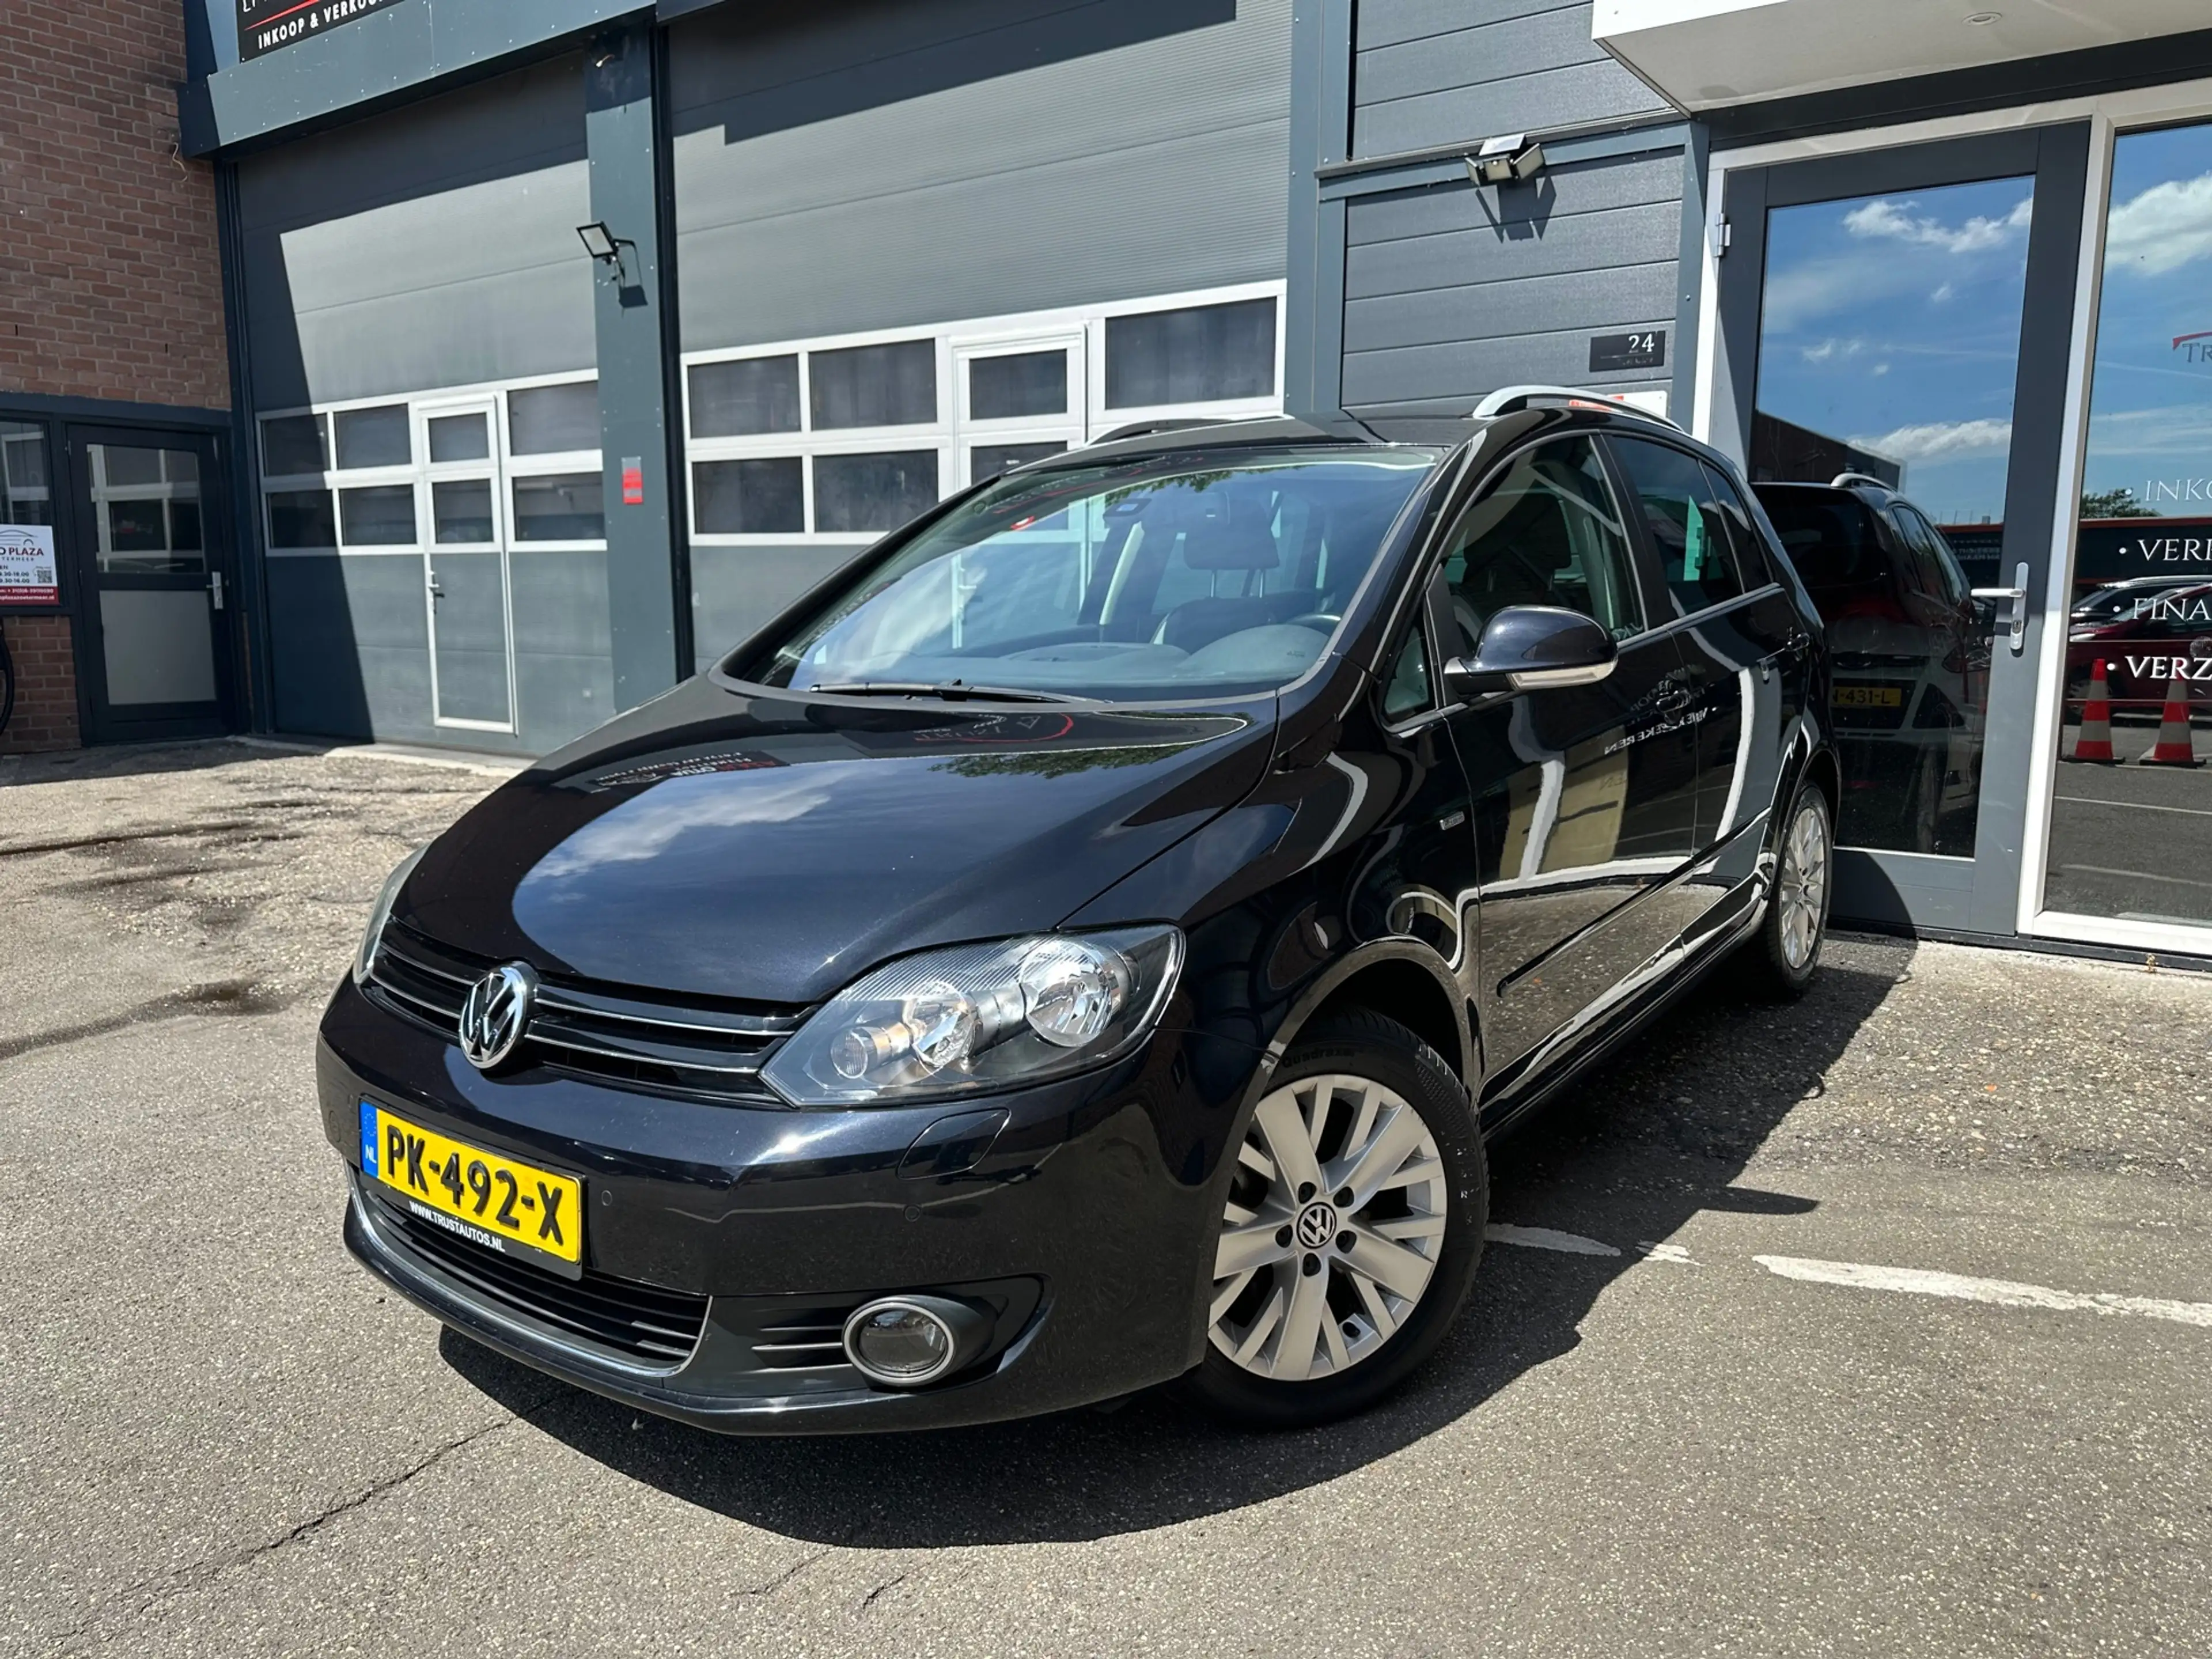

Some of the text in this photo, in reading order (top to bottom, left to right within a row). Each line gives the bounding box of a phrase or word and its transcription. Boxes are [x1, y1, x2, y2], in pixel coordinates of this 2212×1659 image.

[258, 0, 384, 50] INKOOP & VERKO
[1628, 333, 1655, 354] 24
[9, 547, 44, 556] PLAZA
[2132, 597, 2212, 622] FINA
[2124, 655, 2212, 681] VERZ
[365, 1144, 377, 1164] NL
[387, 1124, 565, 1247] PK-492-X
[408, 1200, 506, 1253] WWW.TRUSTAUTOS.NL
